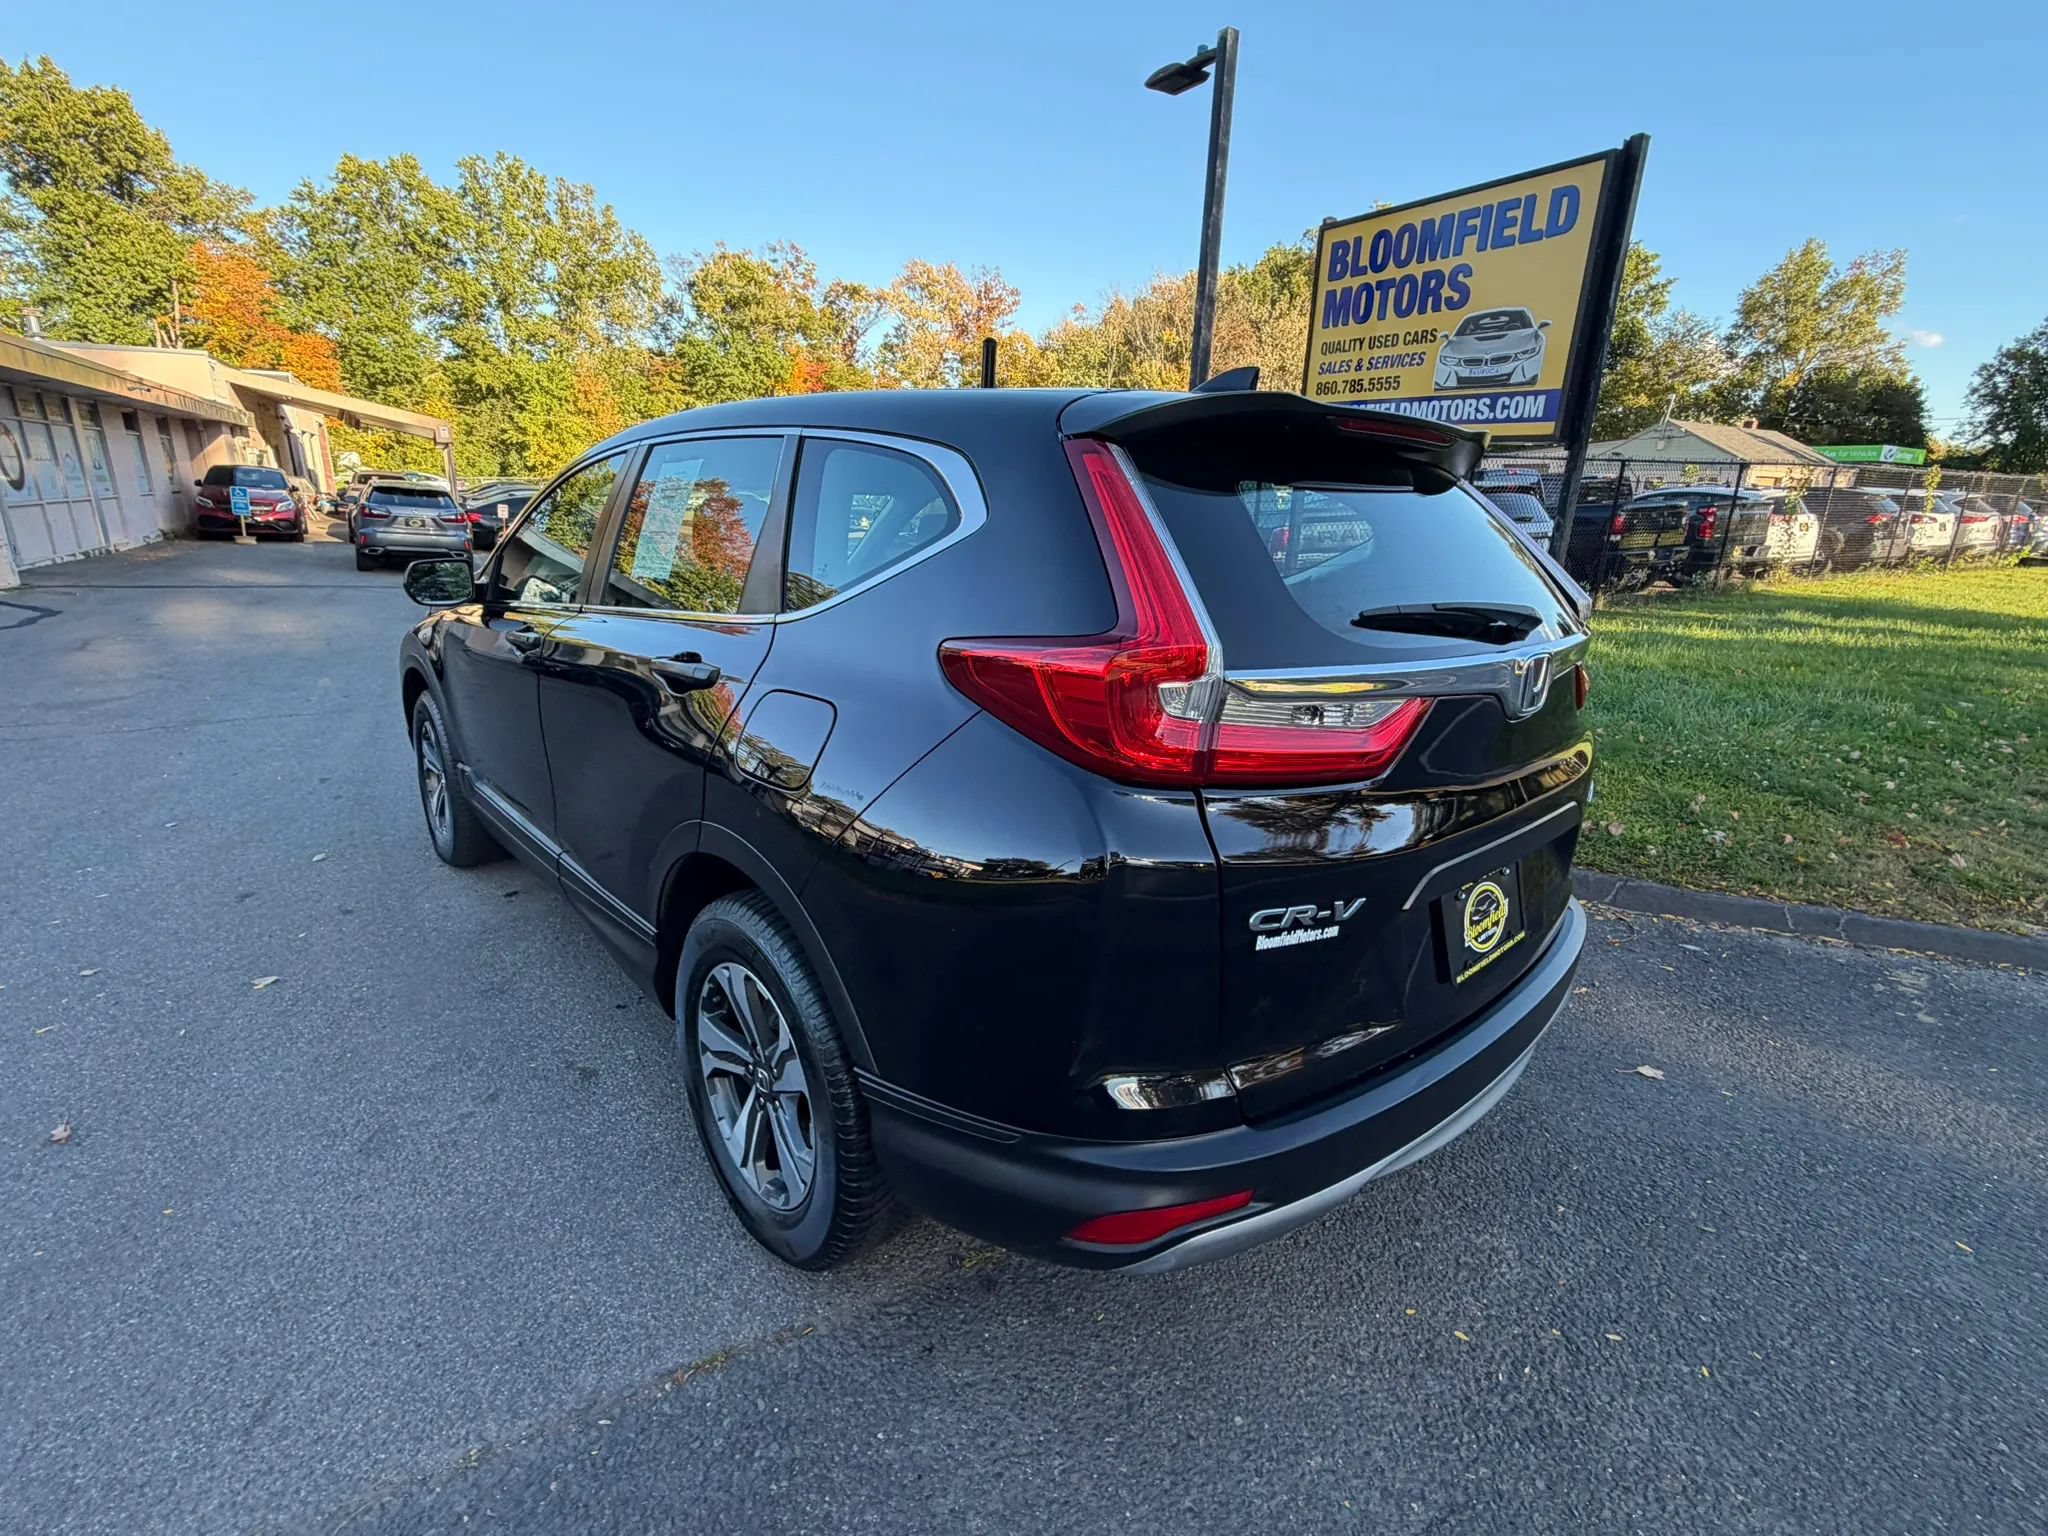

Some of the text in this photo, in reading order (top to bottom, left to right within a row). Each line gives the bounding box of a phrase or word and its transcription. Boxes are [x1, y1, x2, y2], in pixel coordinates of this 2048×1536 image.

[1327, 184, 1581, 282] BLOOMFIELD
[1322, 264, 1473, 329] MOTORS
[1320, 328, 1438, 356] QUALITY USED CARS
[1318, 351, 1426, 376] SALES & SERVICES
[1315, 375, 1401, 396] 860.785.5555
[1249, 897, 1367, 931] CR-V
[1255, 925, 1340, 951] BloomfieldMotors.com
